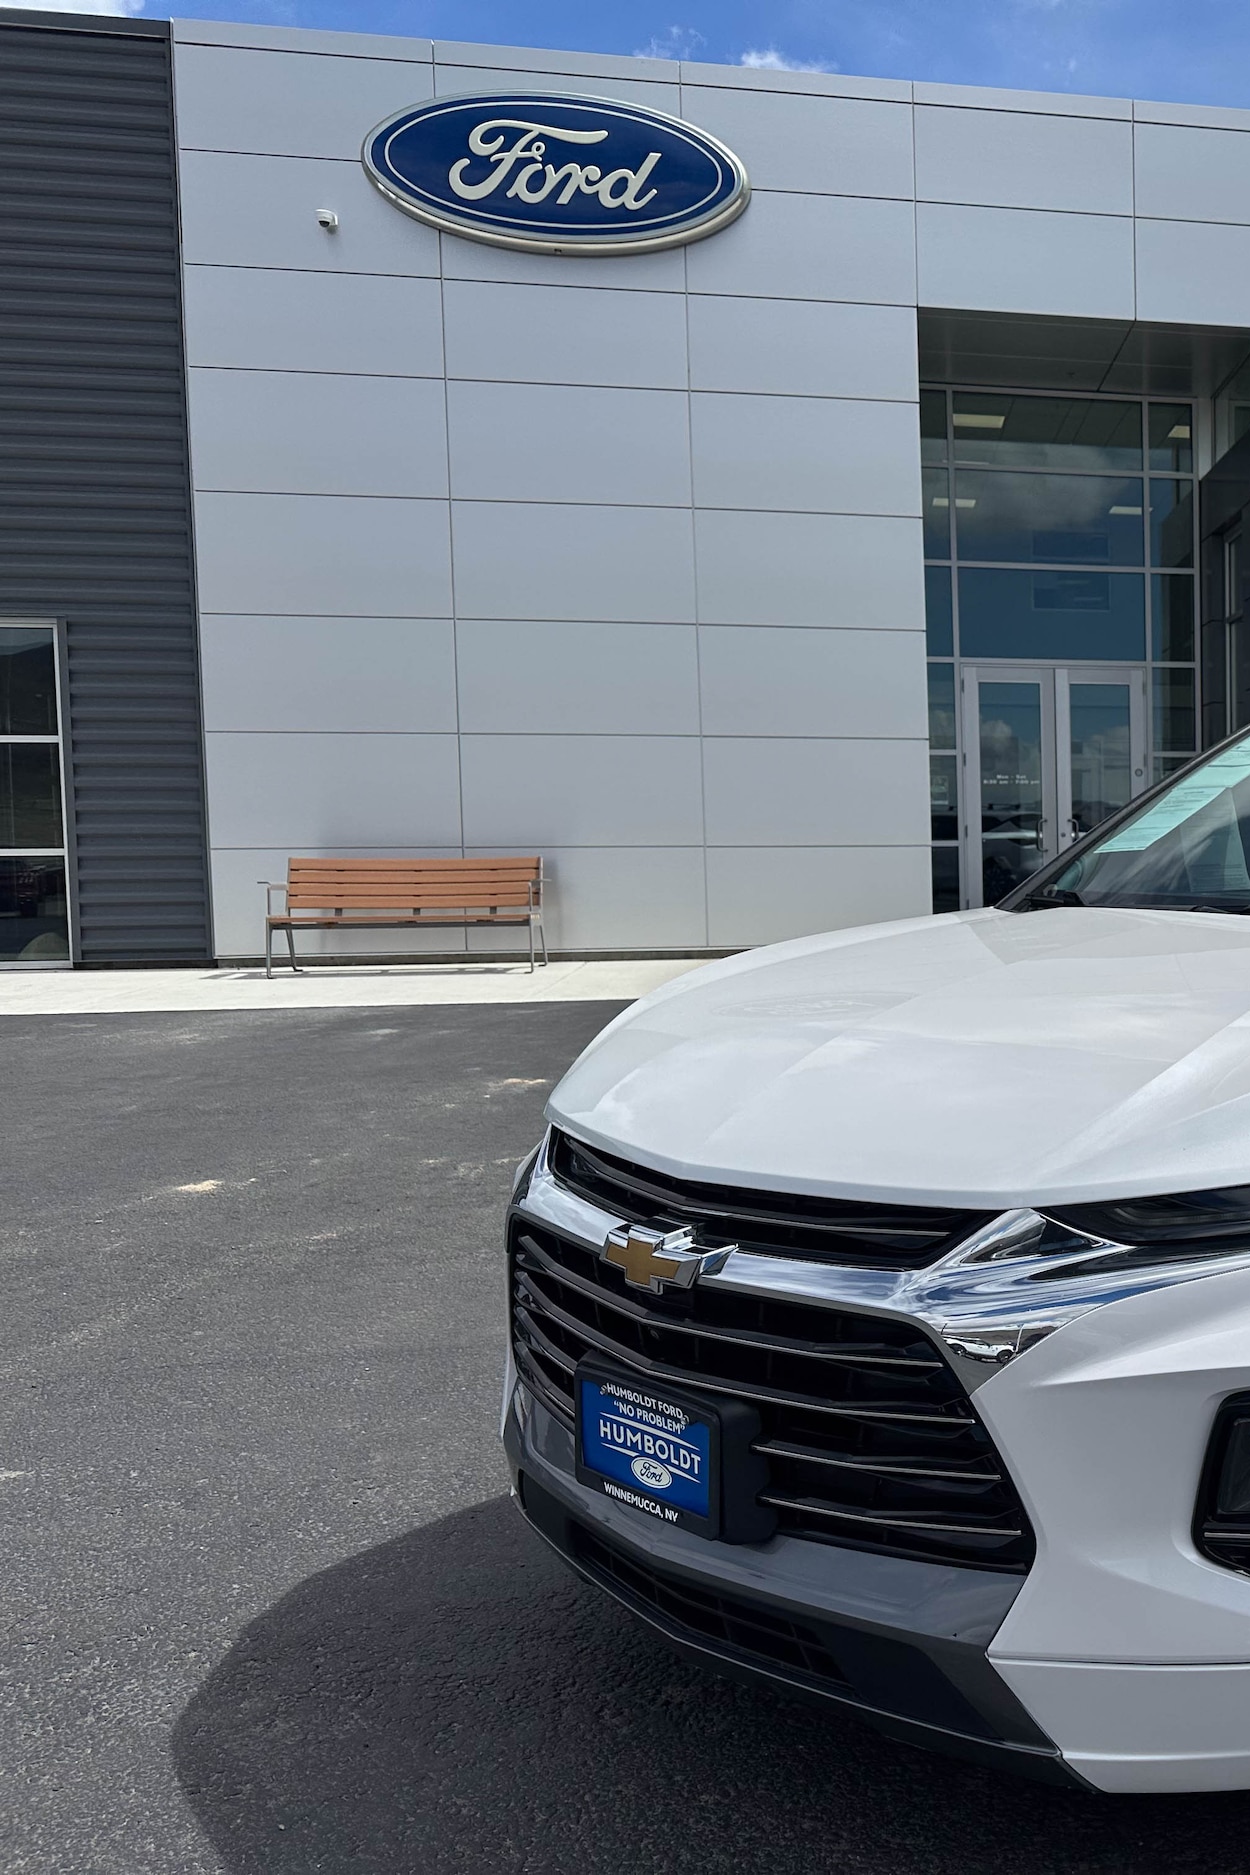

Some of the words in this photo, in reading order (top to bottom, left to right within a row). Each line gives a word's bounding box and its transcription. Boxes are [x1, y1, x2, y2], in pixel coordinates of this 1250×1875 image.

[448, 119, 662, 211] Ford
[606, 1383, 657, 1409] HUMBOLDT
[658, 1401, 683, 1419] FORD
[599, 1419, 701, 1475] HUMBOLDT
[639, 1461, 663, 1483] Ford
[604, 1481, 664, 1518] WINNEMUCCA,
